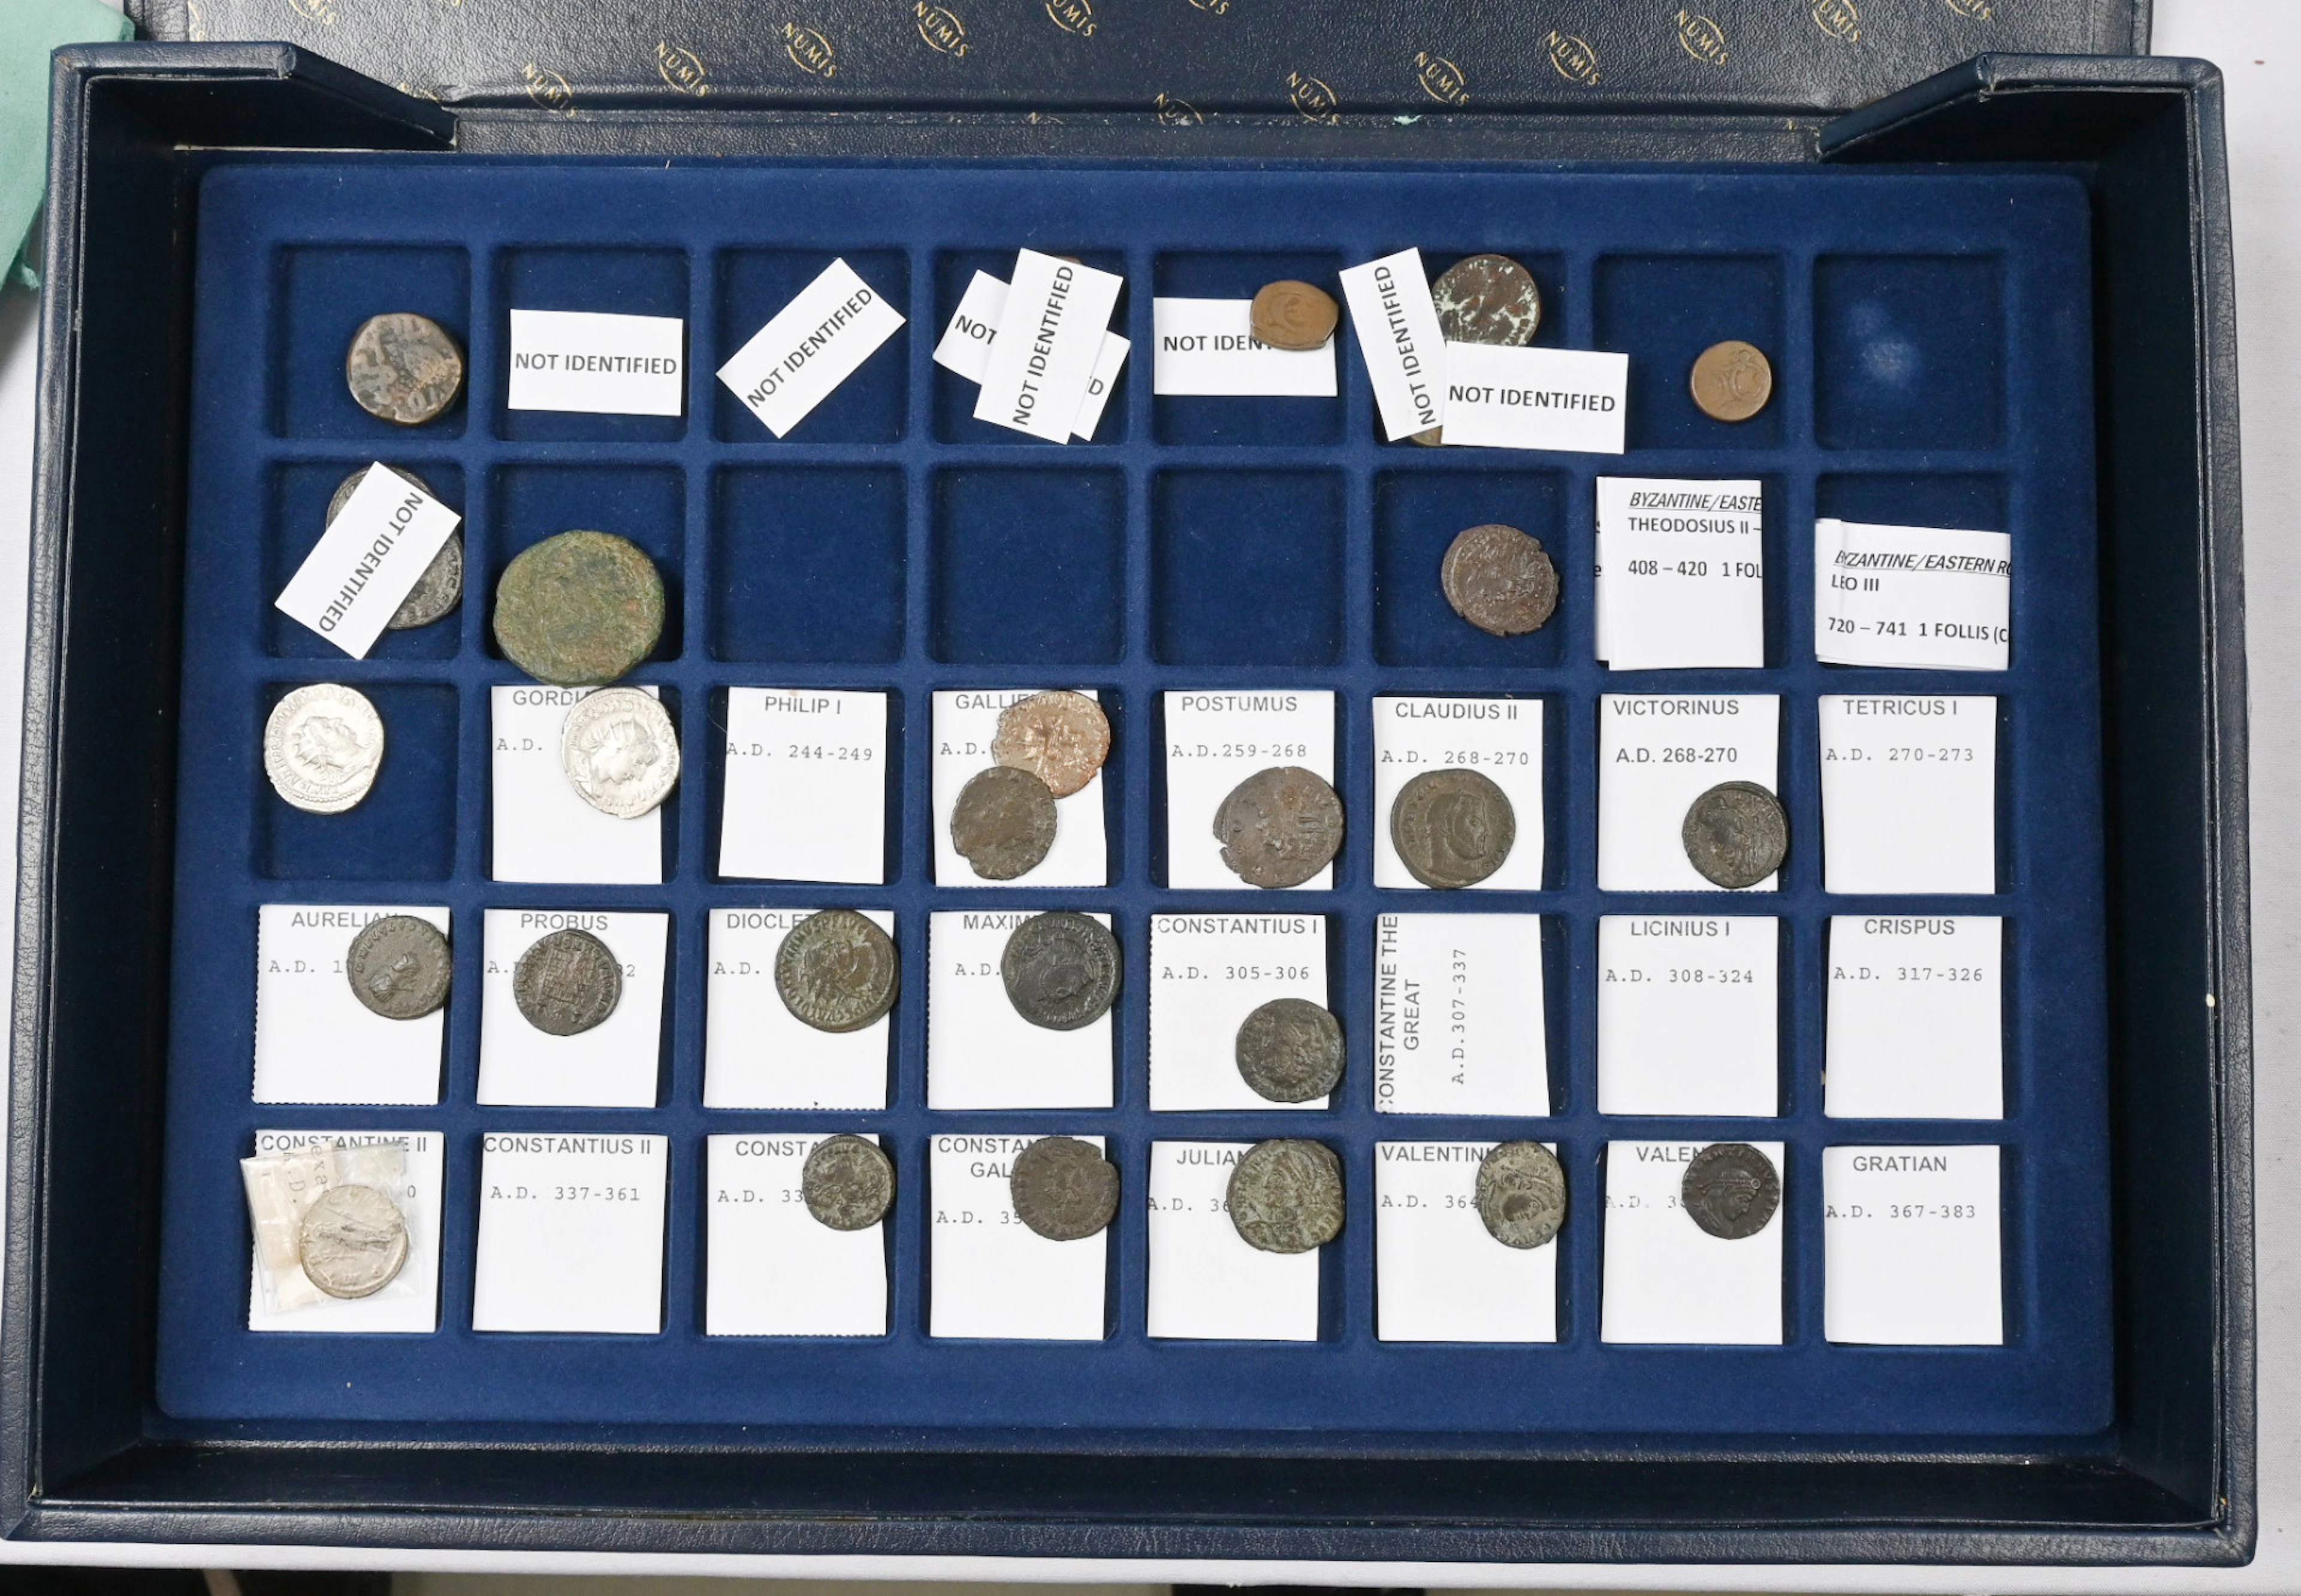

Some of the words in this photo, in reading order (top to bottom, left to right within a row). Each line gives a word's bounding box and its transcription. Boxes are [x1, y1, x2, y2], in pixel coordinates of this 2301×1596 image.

[913, 1, 970, 58] NUMIS
[1675, 10, 1729, 66] NUMIS
[781, 22, 838, 78] NUMIS
[1544, 30, 1601, 86] NUMIS
[654, 41, 711, 98] NUMIS
[1414, 51, 1470, 106] NUMIS
[955, 315, 998, 345] NOT
[1374, 266, 1421, 377] IDENTIFIED
[747, 373, 786, 407] NOT
[783, 288, 872, 373] IDENTIFIED
[1013, 380, 1038, 426] NOT
[1027, 265, 1074, 377] IDENTIFIED
[1164, 335, 1207, 352] NOT
[515, 353, 559, 370] NOT
[565, 355, 677, 375] IDENTIFIED
[1410, 383, 1436, 425] NOT
[1450, 385, 1494, 403] NOT
[1500, 389, 1615, 412] IDENTIFIED
[389, 492, 424, 536] NOT
[1627, 517, 1735, 534] THEODOSIUS
[1740, 520, 1749, 534] II
[1628, 560, 1658, 575] 408
[1677, 561, 1707, 576] 420
[1722, 562, 1731, 577] 1
[1835, 549, 1995, 572] BYZANTINE/EASTERN
[318, 533, 395, 632] IDENTIFIED
[1831, 574, 1858, 590] LEO
[1864, 578, 1879, 591] III
[1828, 617, 1855, 634] 720
[1876, 621, 1907, 636] 741
[1919, 622, 1928, 637] 1
[1935, 622, 1989, 640] FOLLIS
[765, 696, 830, 713] PHILIP
[837, 699, 841, 714] I
[1182, 696, 1297, 712] POSTUMUS
[1396, 702, 1500, 719] CLAUDIUS
[1508, 705, 1517, 720] II
[1613, 700, 1739, 715] VICTORINUS
[1843, 700, 1945, 715] TETRICUS
[1953, 700, 1957, 715] I
[496, 738, 543, 751] A.D.
[726, 743, 772, 757] A.D.
[789, 745, 872, 760] 244-249
[941, 742, 986, 755] A.D.
[1381, 750, 1427, 763] A.D.
[1445, 751, 1529, 766] 268-270
[1663, 748, 1738, 763] 268-270
[1826, 748, 1872, 761] A.D.
[1889, 748, 1974, 761] 270-273
[521, 913, 608, 930] PROBUS
[1158, 918, 1306, 934] CONSTANTIUS
[1313, 919, 1317, 934] I
[1630, 920, 1719, 936] LICINIUS
[1725, 921, 1730, 936] I
[1864, 918, 1956, 935] CRISPUS
[1381, 915, 1398, 957] THE
[268, 960, 315, 973] A.D.
[714, 962, 760, 975] A.D.
[955, 963, 1000, 976] A.D.
[1162, 966, 1208, 980] A.D.
[1225, 966, 1309, 980] 305-306
[1834, 967, 1880, 980] A.D.
[1898, 967, 1983, 981] 317-326
[1605, 969, 1651, 983] A.D.
[1669, 969, 1753, 983] 308-324
[1403, 978, 1420, 1050] GREAT
[417, 1137, 427, 1152] II
[484, 1136, 633, 1154] CONSTANTIUS
[641, 1139, 651, 1154] II
[1853, 1156, 1947, 1172] GRATIAN
[491, 1186, 537, 1199] A.D.
[555, 1186, 640, 1201] 337-361
[717, 1190, 764, 1203] A.D.
[1381, 1195, 1427, 1208] A.D.
[1149, 1197, 1192, 1211] A.D.
[1826, 1205, 1872, 1218] A.D.
[1891, 1205, 1976, 1219] 367-383
[936, 1211, 983, 1224] A.D.
